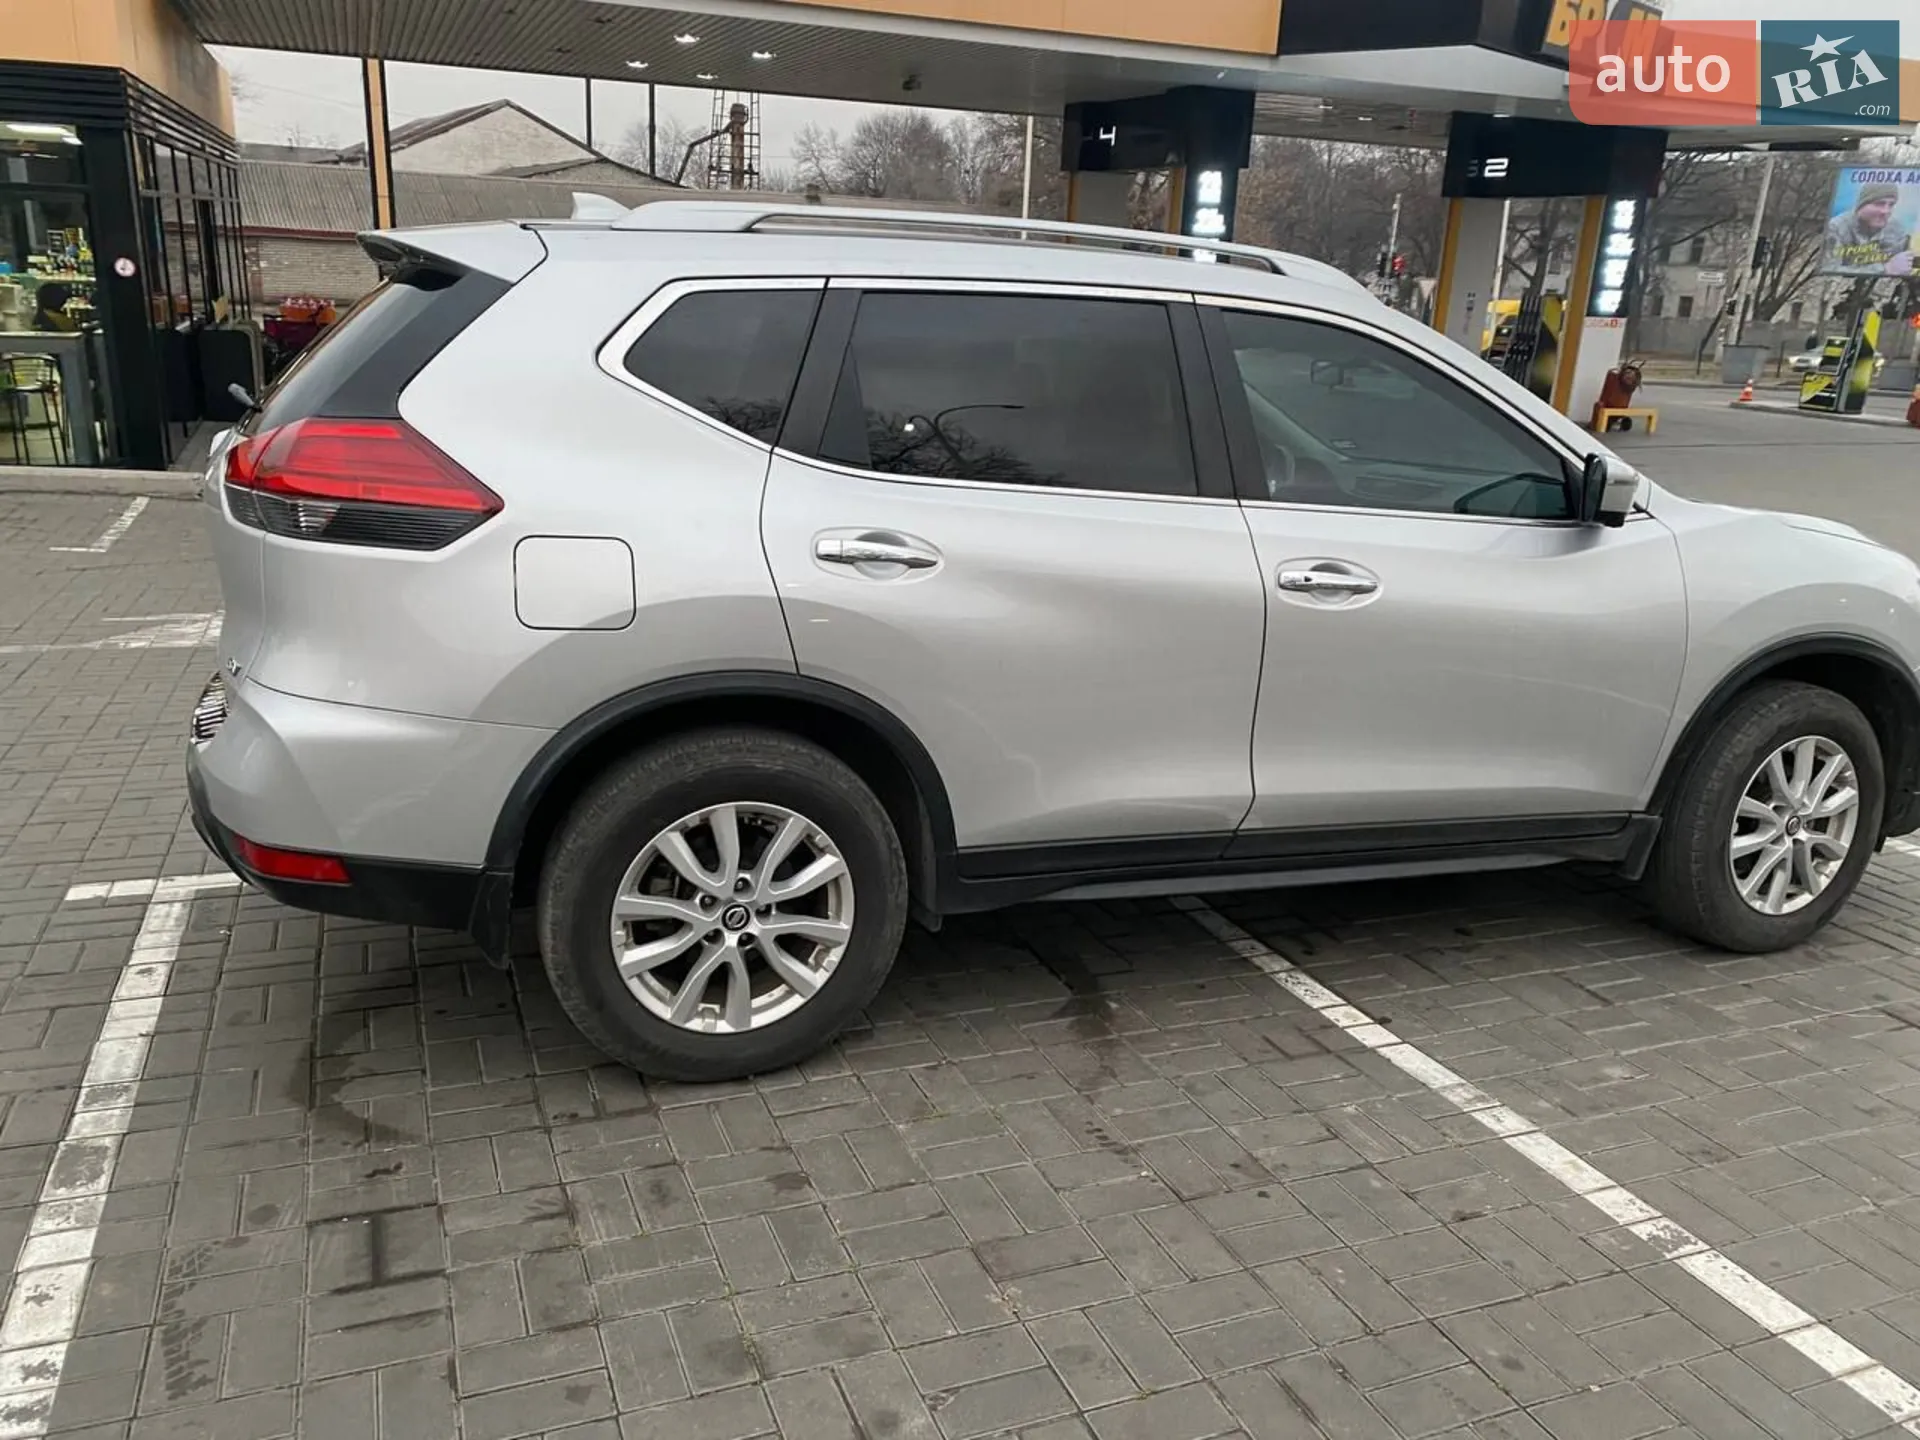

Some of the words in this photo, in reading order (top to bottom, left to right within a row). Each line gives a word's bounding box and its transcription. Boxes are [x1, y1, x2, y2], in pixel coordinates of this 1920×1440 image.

[1099, 125, 1117, 147] 4
[1483, 157, 1509, 178] 2
[1851, 170, 1902, 184] СОЛОХА
